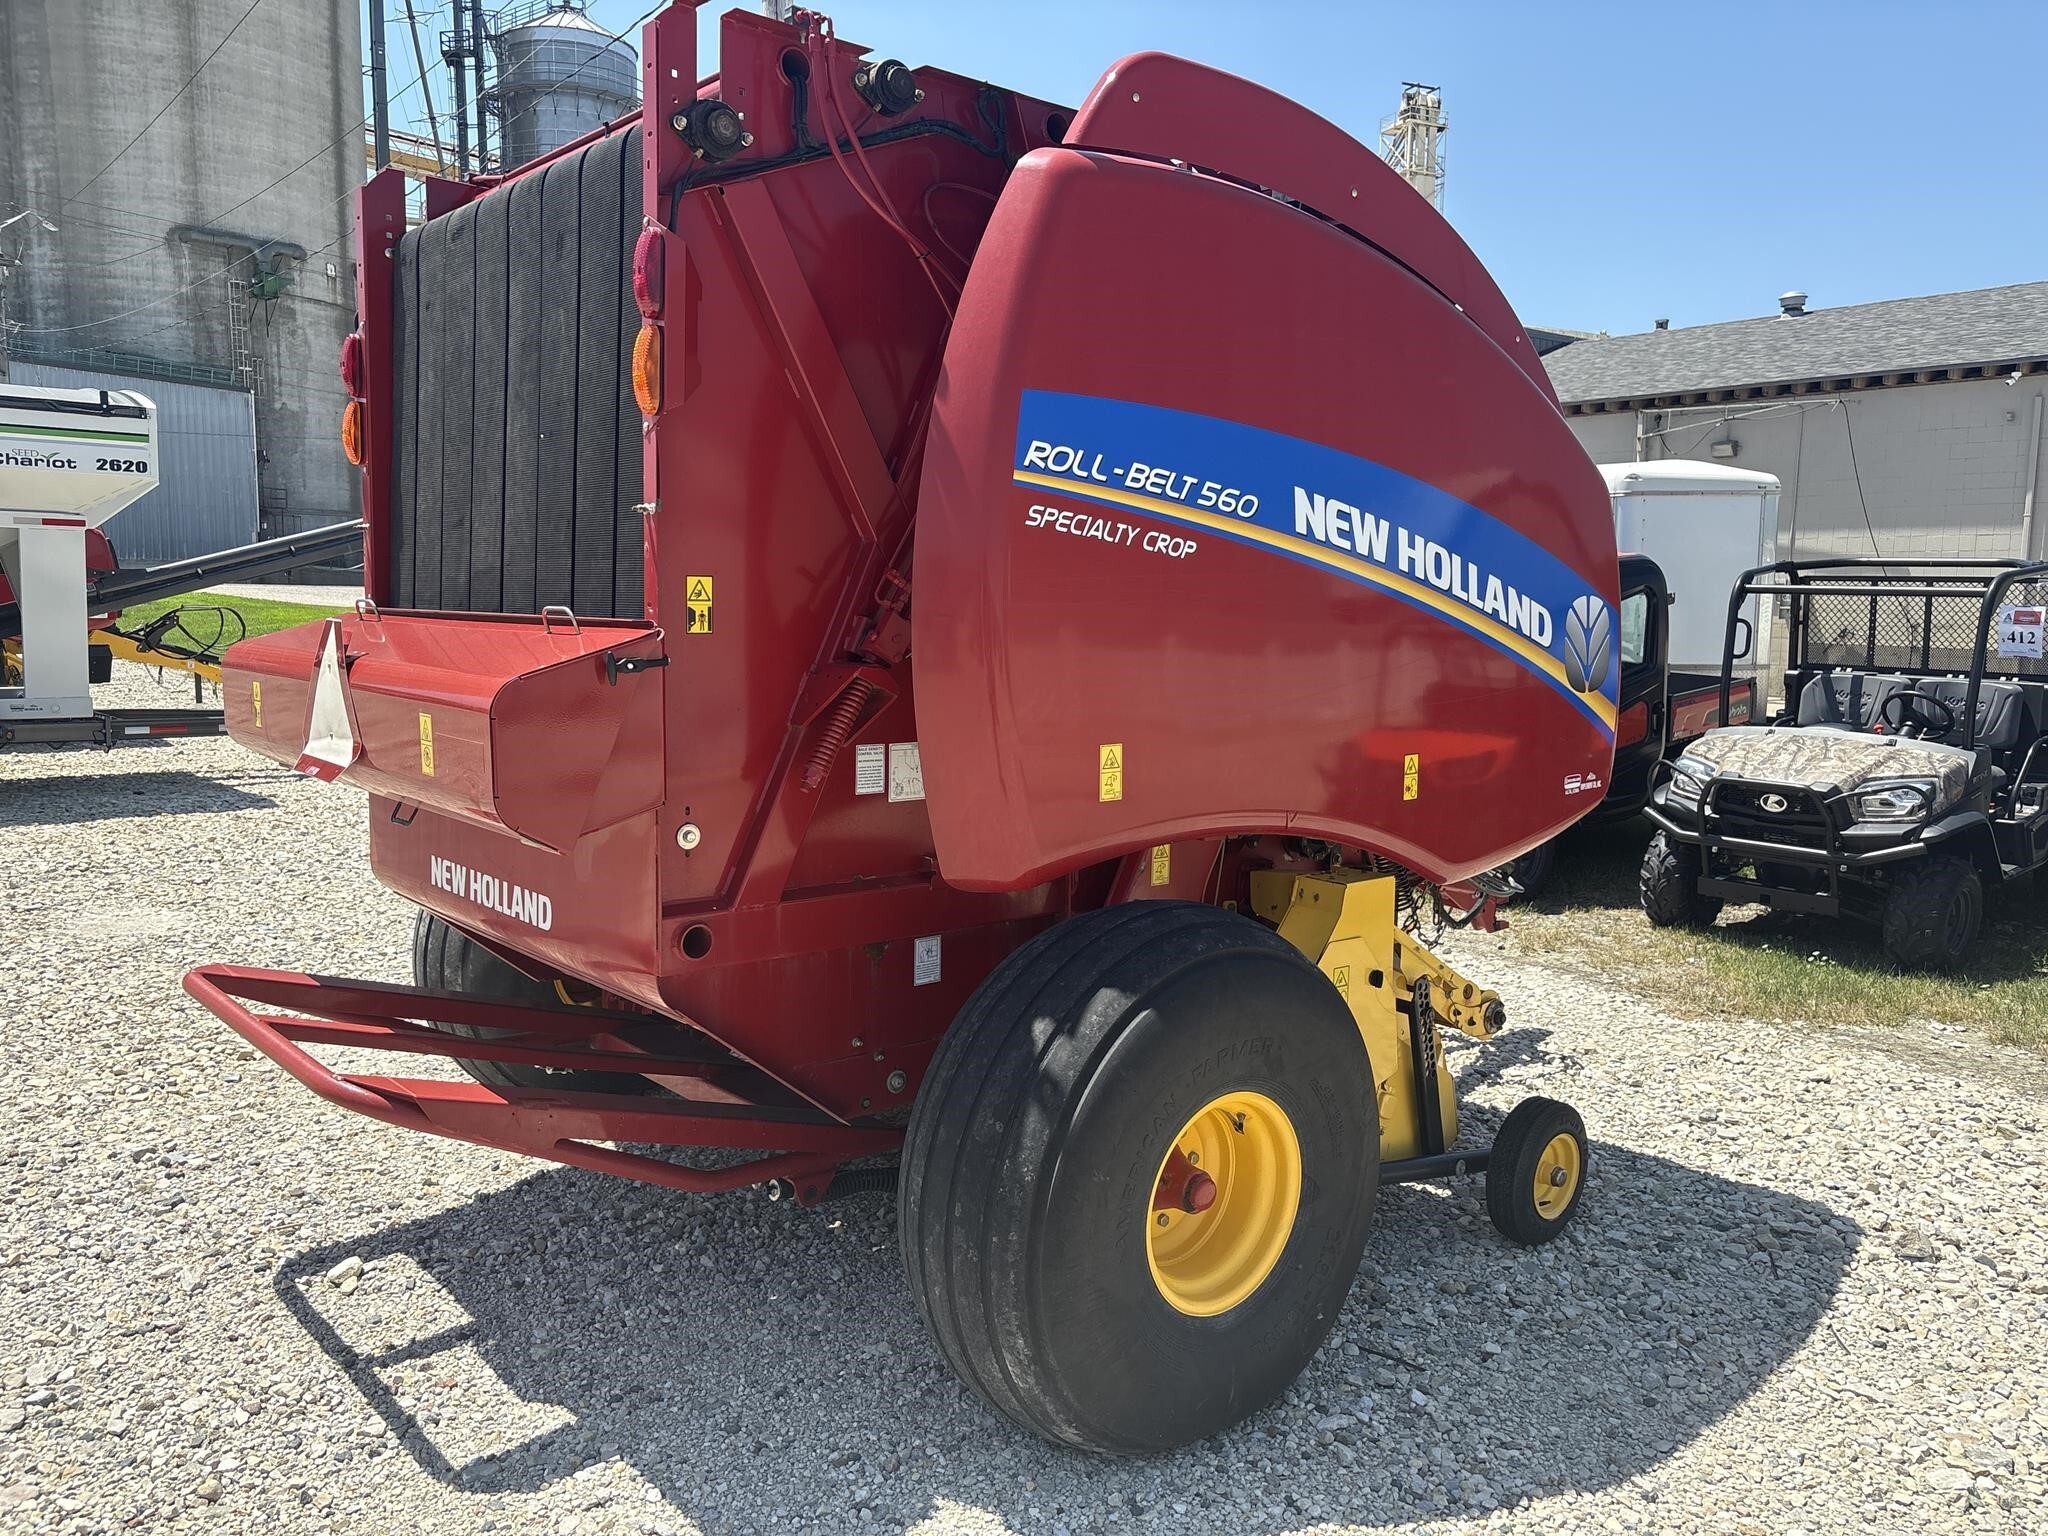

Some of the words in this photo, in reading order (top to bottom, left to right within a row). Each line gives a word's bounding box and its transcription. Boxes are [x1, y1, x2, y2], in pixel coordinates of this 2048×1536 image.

[11, 448, 40, 458] SEED
[95, 458, 148, 473] 2620
[1023, 440, 1199, 501] ROLL-BELT
[1197, 481, 1260, 519] 560
[1025, 504, 1141, 547] SPECIALTY
[1142, 531, 1198, 560] CROP
[1294, 486, 1390, 563] NEW
[1397, 526, 1553, 648] HOLLAND
[1835, 689, 1873, 702] Kuta
[1944, 696, 1986, 710] Kuba
[430, 854, 467, 898] NEW
[469, 868, 553, 932] HOLLAND
[1190, 1036, 1275, 1086] FARMER
